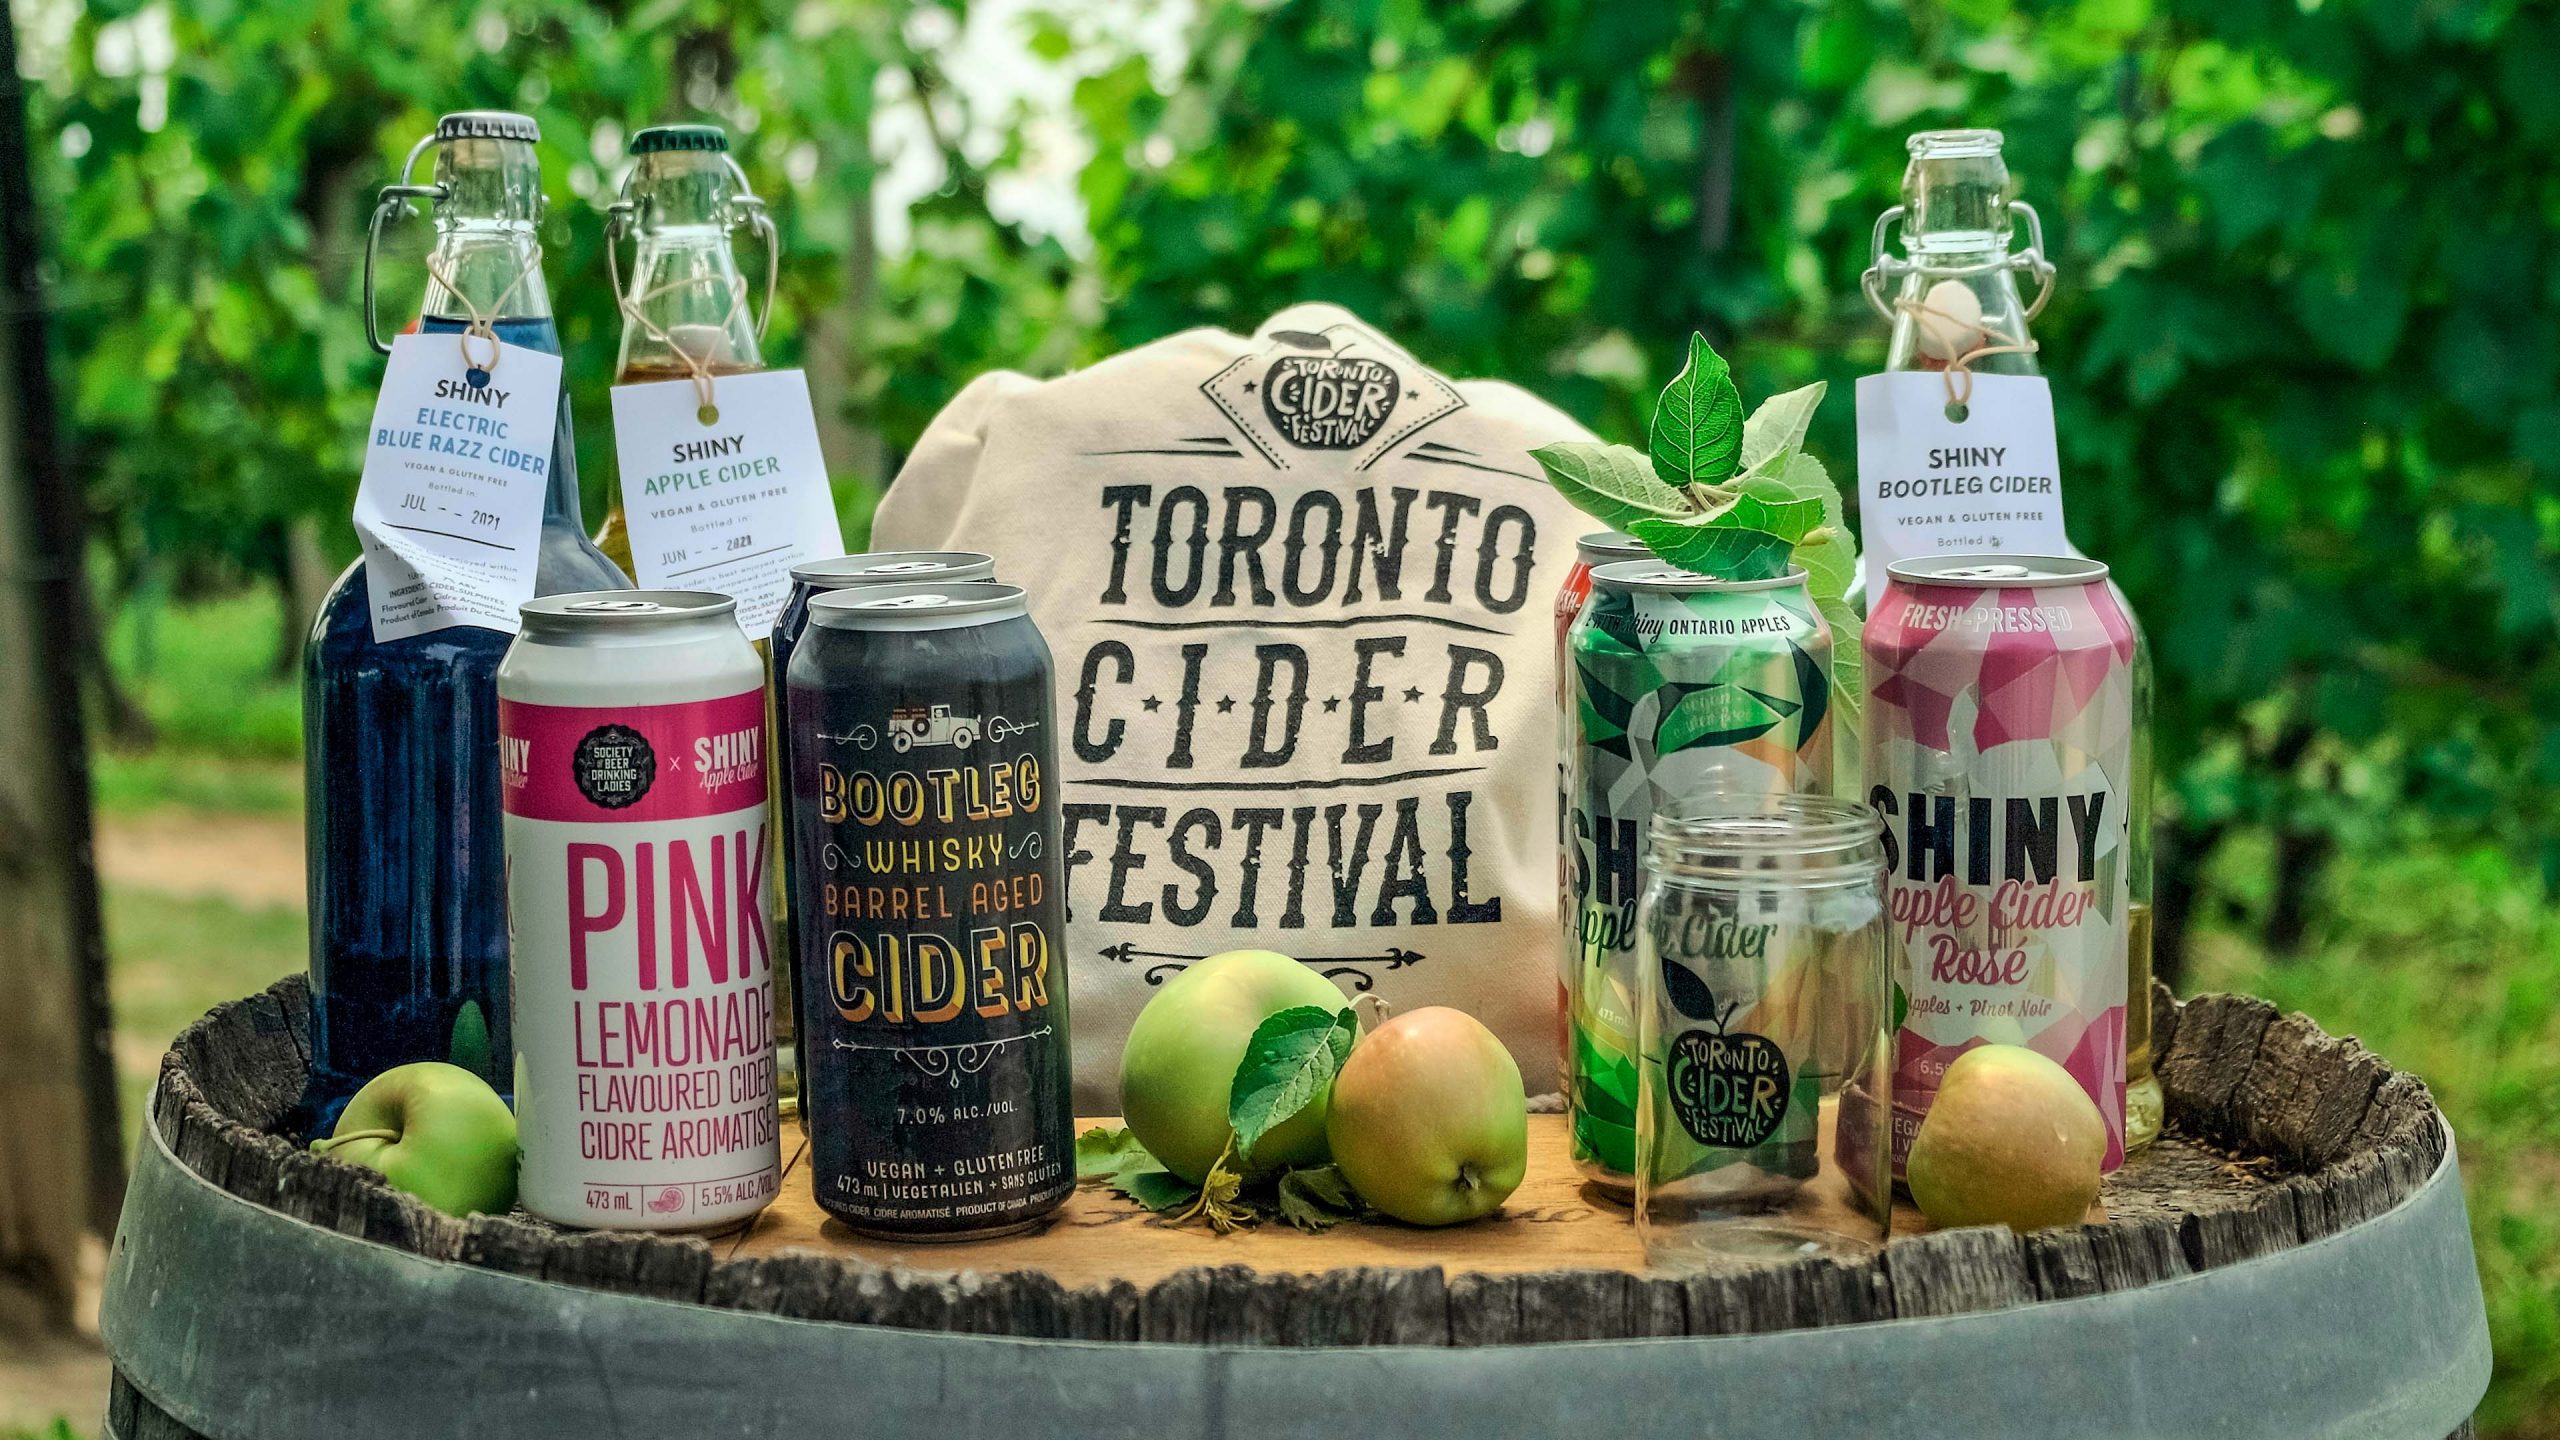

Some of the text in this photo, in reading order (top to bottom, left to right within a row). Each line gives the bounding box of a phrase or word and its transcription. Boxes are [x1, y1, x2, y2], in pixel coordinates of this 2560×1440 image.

[1294, 359, 1383, 382] TORONTO
[434, 379, 511, 409] SHINY
[1271, 368, 1387, 421] CIDER
[417, 407, 509, 439] ELECTRIC
[1291, 414, 1368, 444] FESTIVAL
[376, 429, 545, 476] BLUE RAZZ CIDER
[673, 435, 744, 464] SHINY
[1928, 447, 2006, 469] SHINY
[404, 461, 437, 474] VEGAN
[448, 468, 485, 482] GLUTEN
[487, 476, 508, 488] FREE
[644, 456, 781, 497] APPLE CIDER
[1878, 475, 2052, 499] BOOTLEG CIDER
[400, 493, 426, 513] JUL
[651, 504, 693, 520] VEGAN
[710, 493, 757, 509] GLUTEN
[761, 486, 788, 499] FREE
[1898, 514, 1943, 526] VEGAN
[1962, 512, 2011, 523] GLUTEN
[2016, 511, 2043, 521] FREE
[690, 518, 733, 534] Bottled
[1938, 536, 1984, 547] Bottled
[661, 549, 687, 567] JUN
[1101, 484, 1536, 615] TORONTO
[1669, 619, 1735, 635] ONTARIO
[1741, 615, 1791, 634] APPLES
[1898, 603, 2073, 633] FRESH-PRESSED
[500, 734, 530, 773] INY
[694, 726, 759, 773] SHINY
[594, 746, 633, 758] SOCIETY
[605, 758, 629, 769] BEER
[591, 769, 637, 780] DRINKING
[597, 780, 631, 792] LADIES
[699, 766, 735, 794] Apple
[819, 753, 1040, 826] BOOTLEG
[1869, 784, 2107, 886] SHINY
[865, 834, 1003, 874] WHISKY
[1061, 791, 1502, 929] FESTIVAL
[567, 822, 771, 991] PINK
[824, 873, 1043, 919] BARREL AGED
[1989, 876, 2095, 931] Cider
[1681, 909, 1778, 959] Cider
[827, 921, 1048, 1023] CIDER
[1928, 933, 2029, 986] Rosé
[1598, 1007, 1614, 1022] 473
[1970, 999, 2014, 1017] Pinot
[2018, 999, 2052, 1017] Noir
[574, 980, 773, 1069] LEMONADE
[1685, 1037, 1769, 1074] TORONTO
[1920, 1060, 1950, 1076] 6.5
[578, 1057, 773, 1113] FLAVOURED CIDER
[1674, 1056, 1778, 1120] CIDER
[897, 1100, 1019, 1125] 7.0% ALC./VOL.
[1692, 1107, 1765, 1144] FESTIVAL
[581, 1098, 774, 1161] CIDRE AROMATISÉ
[867, 1161, 926, 1179] VEGAN
[954, 1152, 1014, 1177] GLUTEN
[1018, 1145, 1044, 1167] FREE
[837, 1174, 861, 1195] 473
[863, 1185, 880, 1198] mL
[892, 1179, 983, 1199] VEGETALIEN
[1001, 1173, 1024, 1190] SANS
[1028, 1162, 1061, 1185] GLUTEN
[585, 1189, 611, 1210] 473
[612, 1191, 633, 1210] mL
[702, 1185, 733, 1207] 5.5%
[874, 1208, 898, 1219] CIDRE
[900, 1206, 951, 1220] AROMATISÉ
[956, 1202, 997, 1217] PRODUCT
